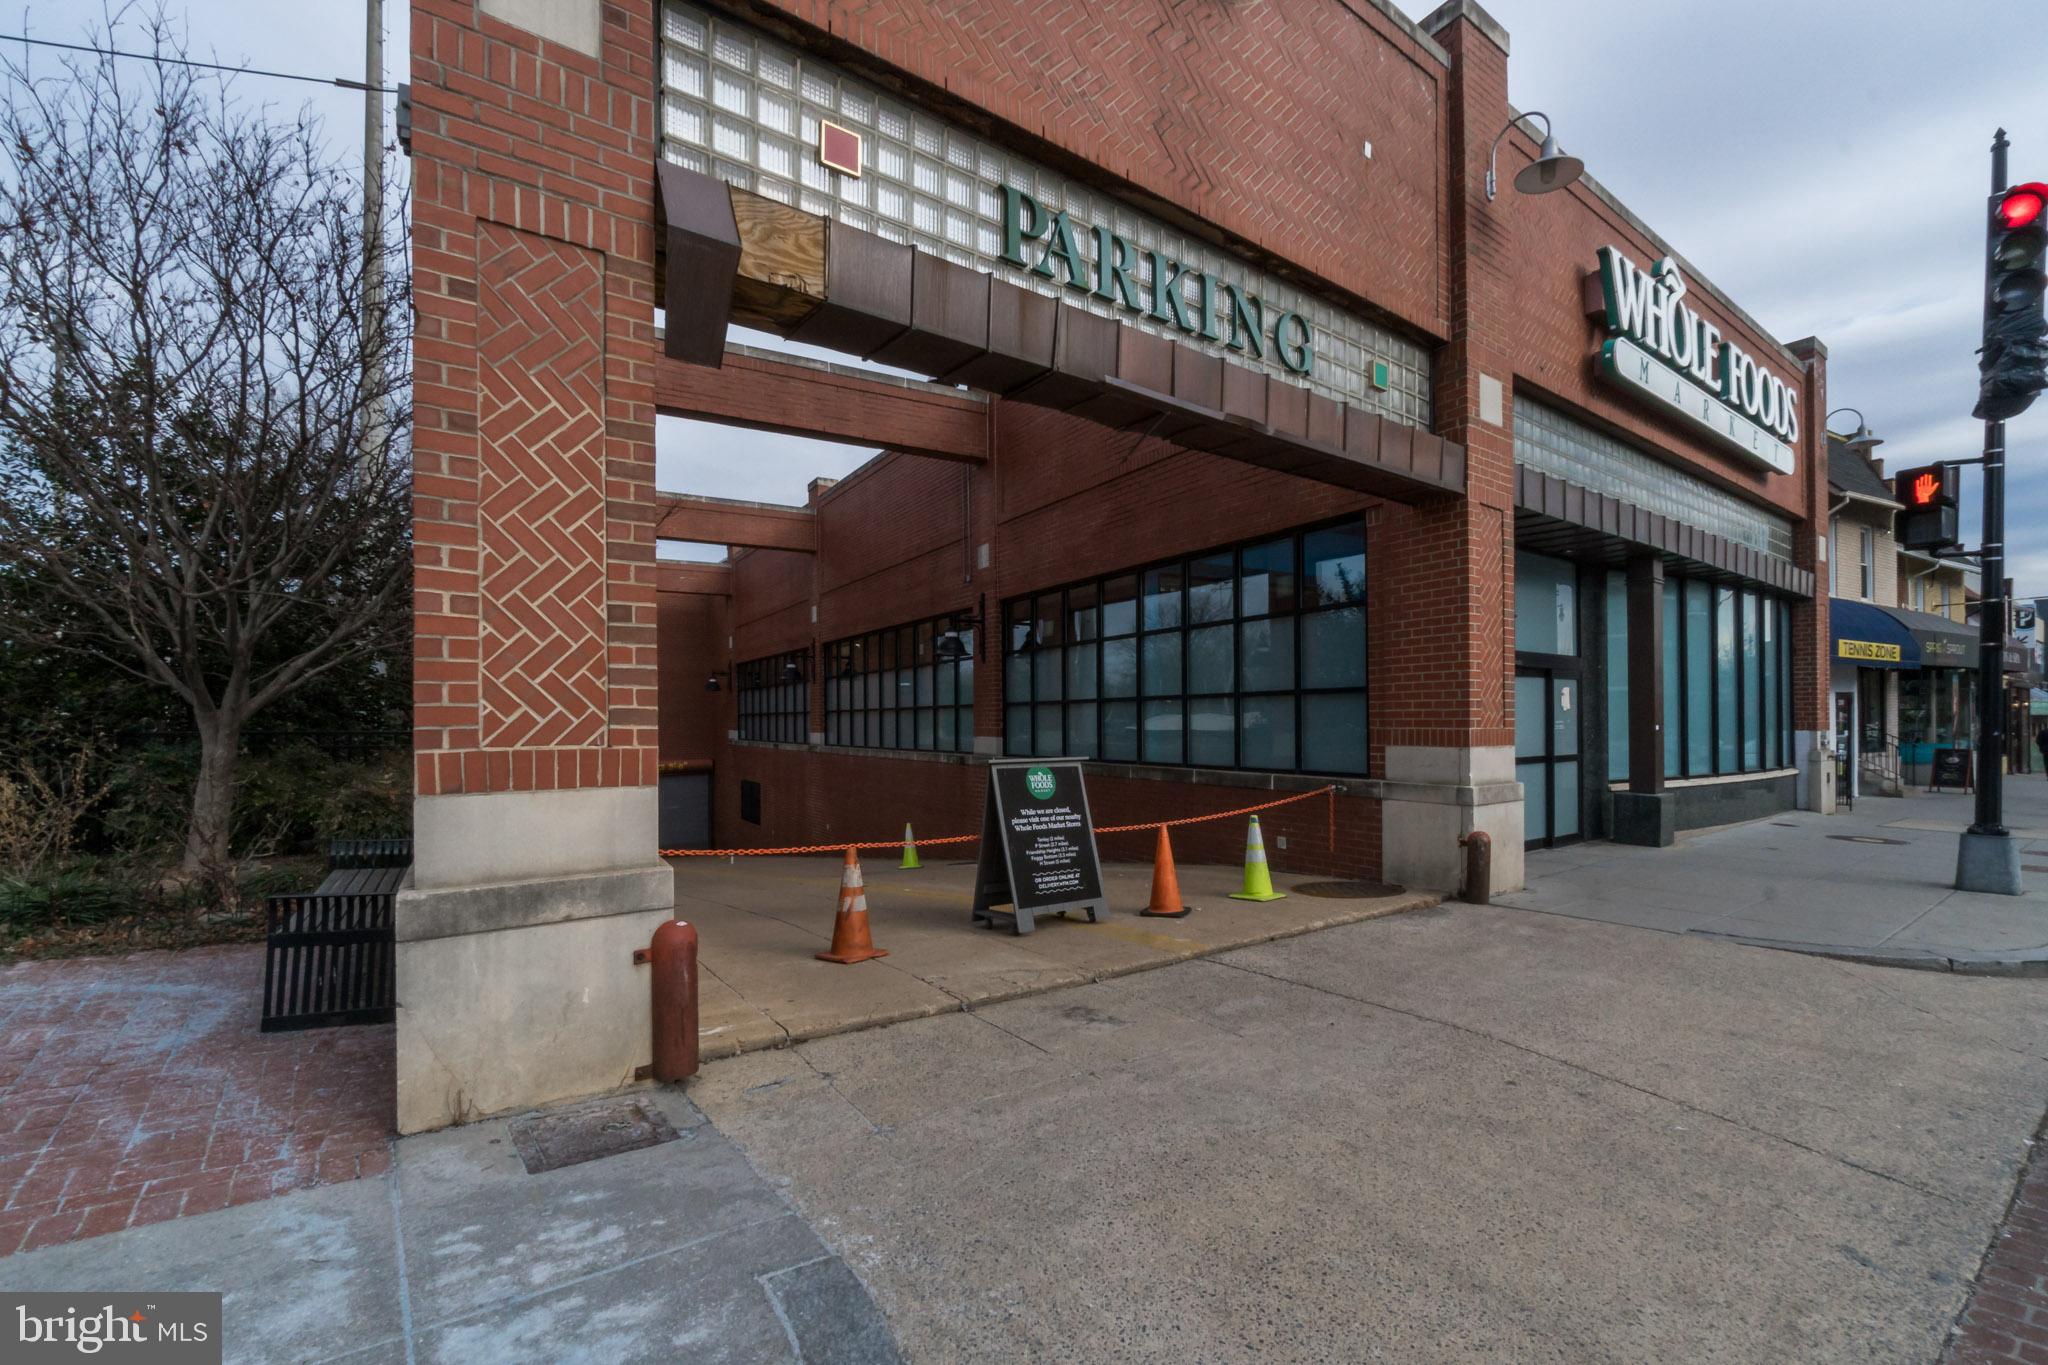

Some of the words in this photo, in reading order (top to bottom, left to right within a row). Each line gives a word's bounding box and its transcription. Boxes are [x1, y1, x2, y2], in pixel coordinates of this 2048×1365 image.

[998, 183, 1311, 376] PARKING
[1598, 246, 1722, 392] WHOLE
[1720, 341, 1798, 444] FOODS
[1638, 357, 1780, 463] MARKET
[1843, 641, 1873, 658] TENNIS
[1875, 644, 1897, 660] ZONE
[1029, 771, 1053, 781] WHOLE
[1031, 780, 1054, 789] FOODS
[1020, 808, 1036, 816] While
[1011, 817, 1029, 826] please
[1048, 821, 1066, 829] Market
[1066, 820, 1081, 828] Stores
